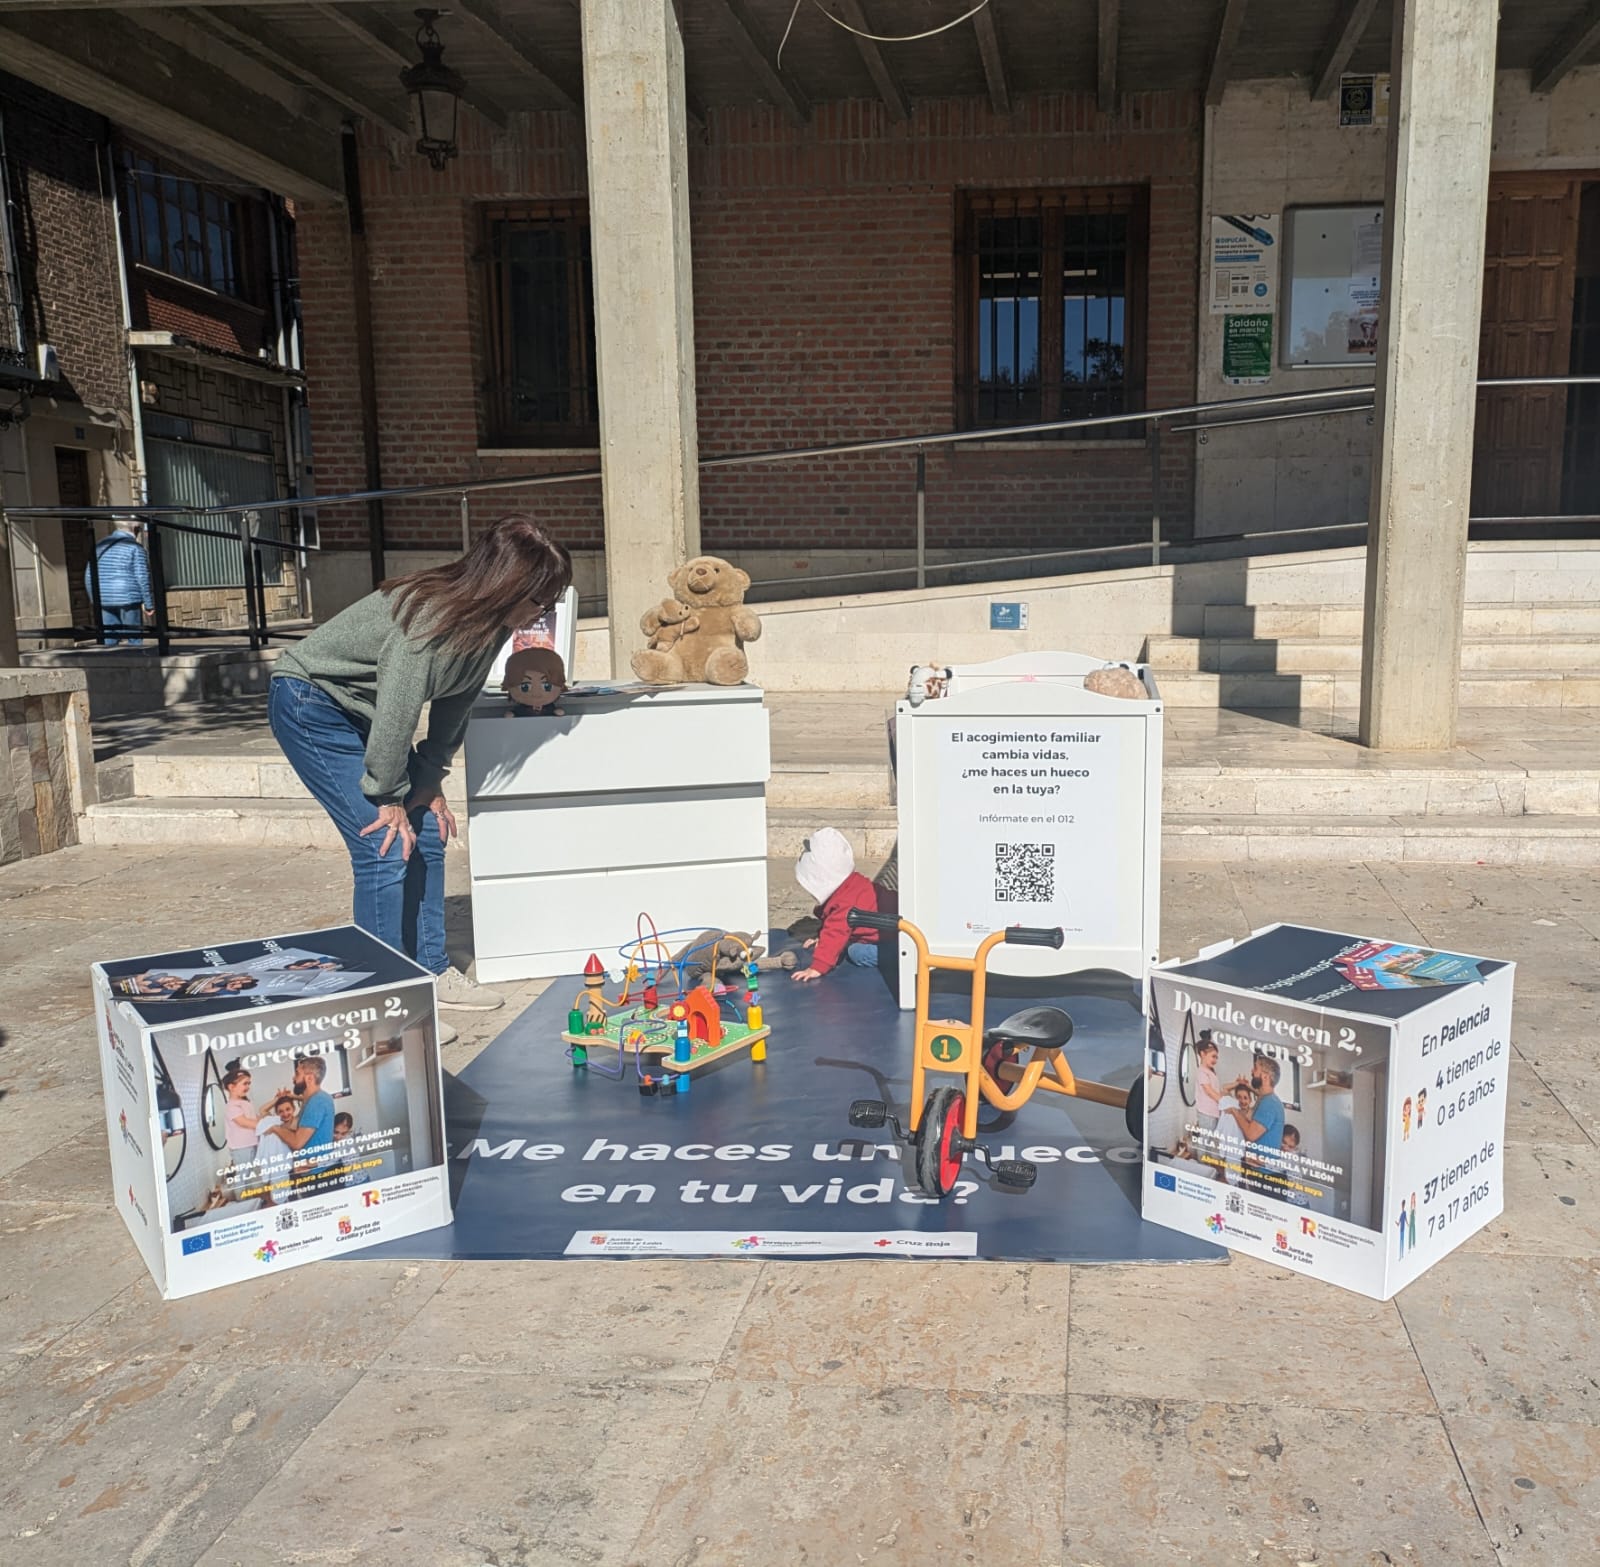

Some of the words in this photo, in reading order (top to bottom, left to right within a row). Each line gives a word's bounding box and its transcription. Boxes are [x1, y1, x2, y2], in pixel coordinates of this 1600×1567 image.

[1228, 318, 1268, 328] Saldaña
[952, 732, 963, 742] El
[966, 732, 1048, 744] acogimiento
[1050, 732, 1101, 743] familiar
[982, 750, 1030, 760] cambia
[1032, 749, 1070, 760] vidas,
[962, 768, 988, 778] ¿me
[991, 766, 1028, 777] haces
[1030, 768, 1048, 777] un
[1050, 766, 1090, 778] hueco
[993, 785, 1009, 794] en
[1012, 784, 1024, 794] la
[1026, 784, 1060, 796] tuya?
[979, 814, 1029, 824] Infórmate
[1030, 816, 1044, 824] en
[1046, 814, 1056, 824] el
[1058, 814, 1075, 824] 012
[185, 1021, 280, 1056] Donde
[286, 1006, 378, 1038] crecen
[384, 996, 408, 1018] 2,
[1173, 990, 1246, 1026] Donde
[1250, 1012, 1332, 1048] crecen
[1337, 1026, 1362, 1057] 2,
[1421, 1034, 1437, 1058] En
[1440, 1004, 1490, 1047] Palencia
[242, 1039, 336, 1070] crecen
[343, 1028, 362, 1050] 3
[940, 1038, 950, 1060] 1
[1212, 1030, 1292, 1063] crecen
[1296, 1044, 1314, 1068] 3
[1435, 1069, 1444, 1091] 4
[1446, 1050, 1484, 1086] tienen
[1486, 1038, 1502, 1061] de
[1436, 1105, 1446, 1127] 0
[1448, 1102, 1456, 1120] a
[1458, 1092, 1466, 1113] 6
[1468, 1076, 1496, 1106] años
[216, 1156, 268, 1177] CAMPAÑA
[270, 1152, 284, 1164] DE
[286, 1138, 354, 1160] ACOGIMIENTO
[355, 1126, 400, 1144] FAMILIAR
[226, 1174, 241, 1185] DE
[242, 1171, 257, 1182] LA
[259, 1162, 292, 1178] JUNTA
[293, 1158, 307, 1168] DE
[308, 1148, 356, 1166] CASTILLA
[358, 1144, 364, 1154] Y
[366, 1138, 392, 1152] LEÓN
[582, 1138, 793, 1161] haces
[812, 1142, 902, 1162] un
[962, 1143, 1144, 1164] ueco
[1184, 1123, 1225, 1141] CAMPAÑA
[1227, 1135, 1239, 1145] DE
[1240, 1138, 1300, 1162] ACOGIMIENTO
[1300, 1156, 1344, 1176] FAMILIAR
[1192, 1136, 1204, 1145] DE
[1204, 1138, 1216, 1148] LA
[1217, 1143, 1244, 1157] JUNTA
[1246, 1151, 1257, 1160] DE
[1258, 1154, 1300, 1173] CASTILLA
[1302, 1166, 1308, 1175] Y
[1309, 1169, 1336, 1184] LEÓN
[240, 1185, 262, 1199] Abre
[296, 1174, 316, 1188] para
[316, 1180, 328, 1190] en
[330, 1178, 338, 1187] el
[1246, 1167, 1264, 1180] para
[1262, 1184, 1274, 1192] en
[1424, 1176, 1439, 1205] 37
[1440, 1156, 1478, 1192] tienen
[1479, 1140, 1495, 1164] de
[560, 1183, 656, 1204] en
[680, 1180, 758, 1204] tu
[1427, 1216, 1436, 1239] 7
[1438, 1214, 1446, 1232] a
[1448, 1198, 1460, 1224] 17
[1462, 1180, 1490, 1212] años
